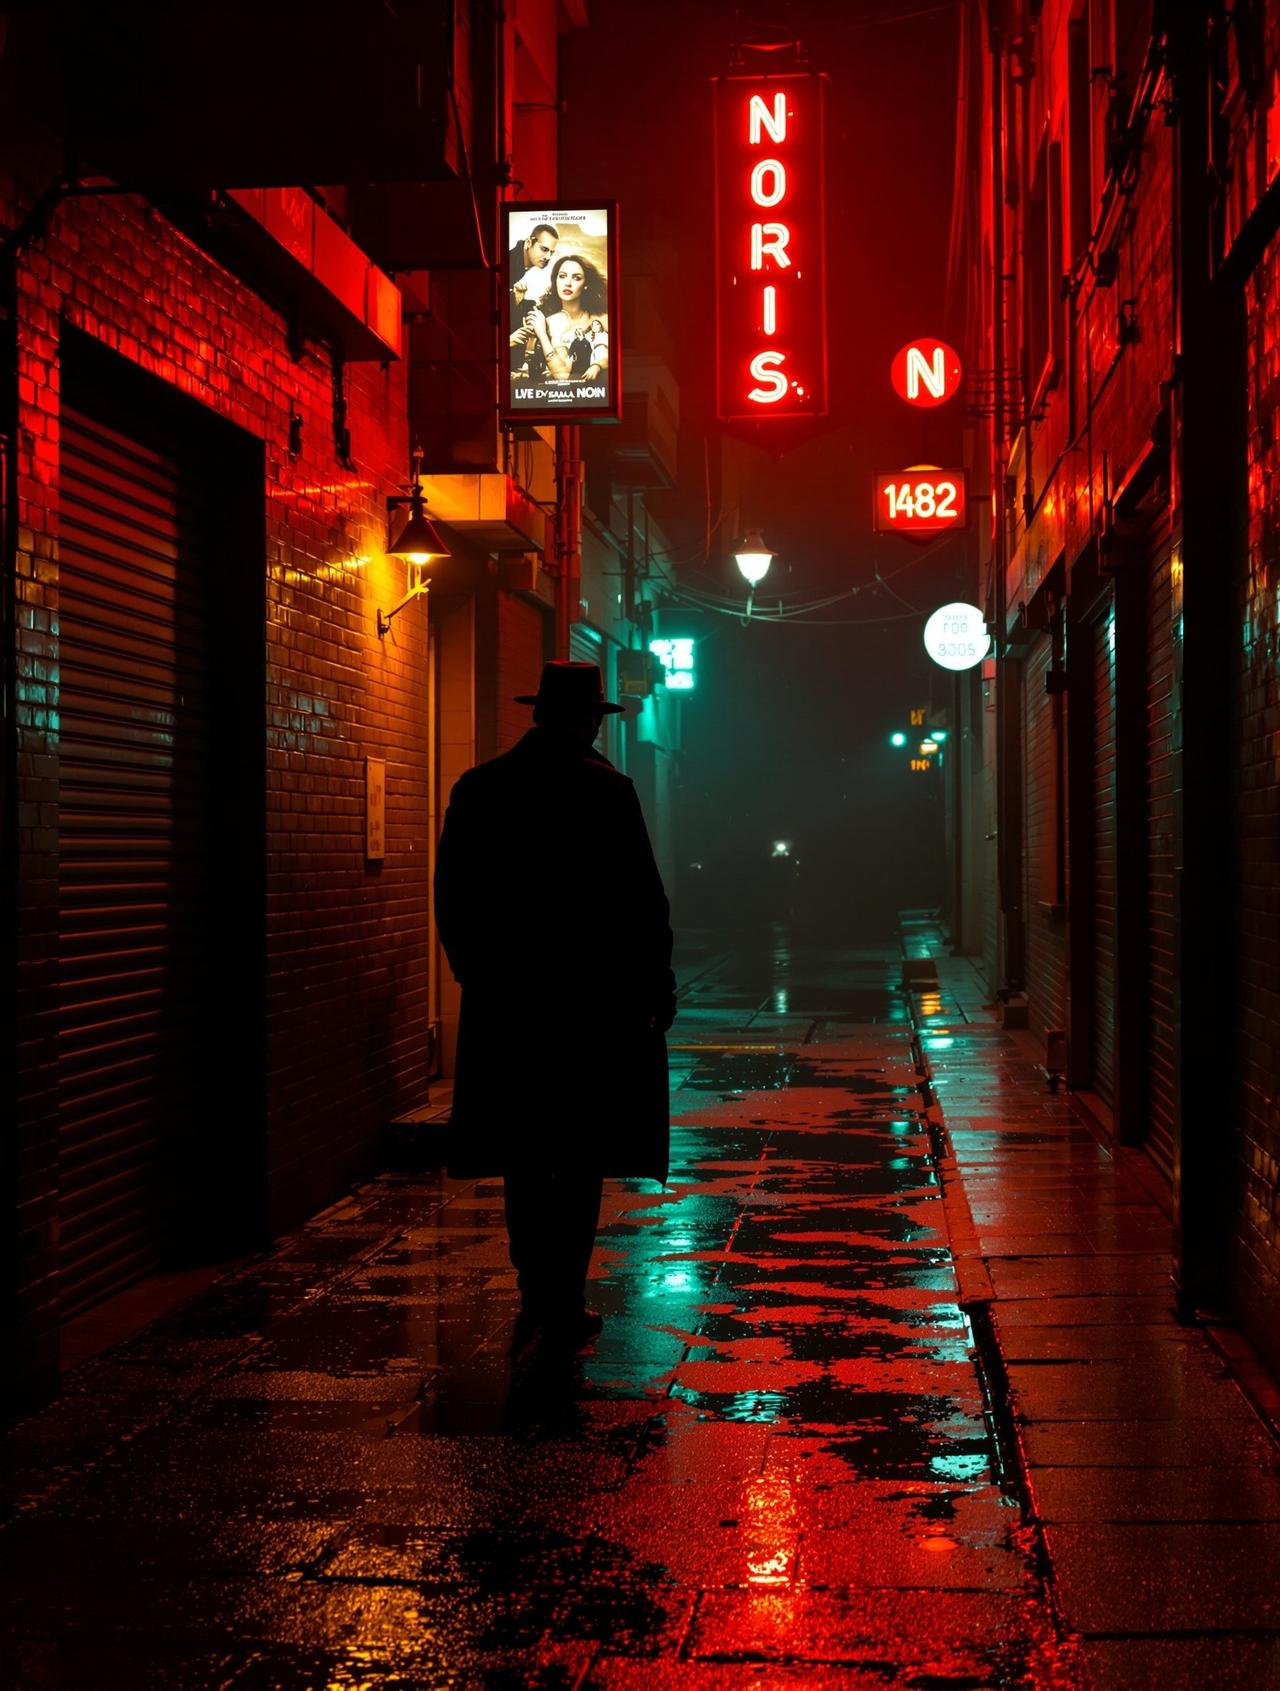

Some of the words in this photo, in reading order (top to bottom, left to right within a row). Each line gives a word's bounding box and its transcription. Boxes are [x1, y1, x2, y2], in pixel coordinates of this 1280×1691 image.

[748, 92, 791, 404] NORIS
[907, 347, 945, 399] N
[884, 482, 957, 519] 1482
